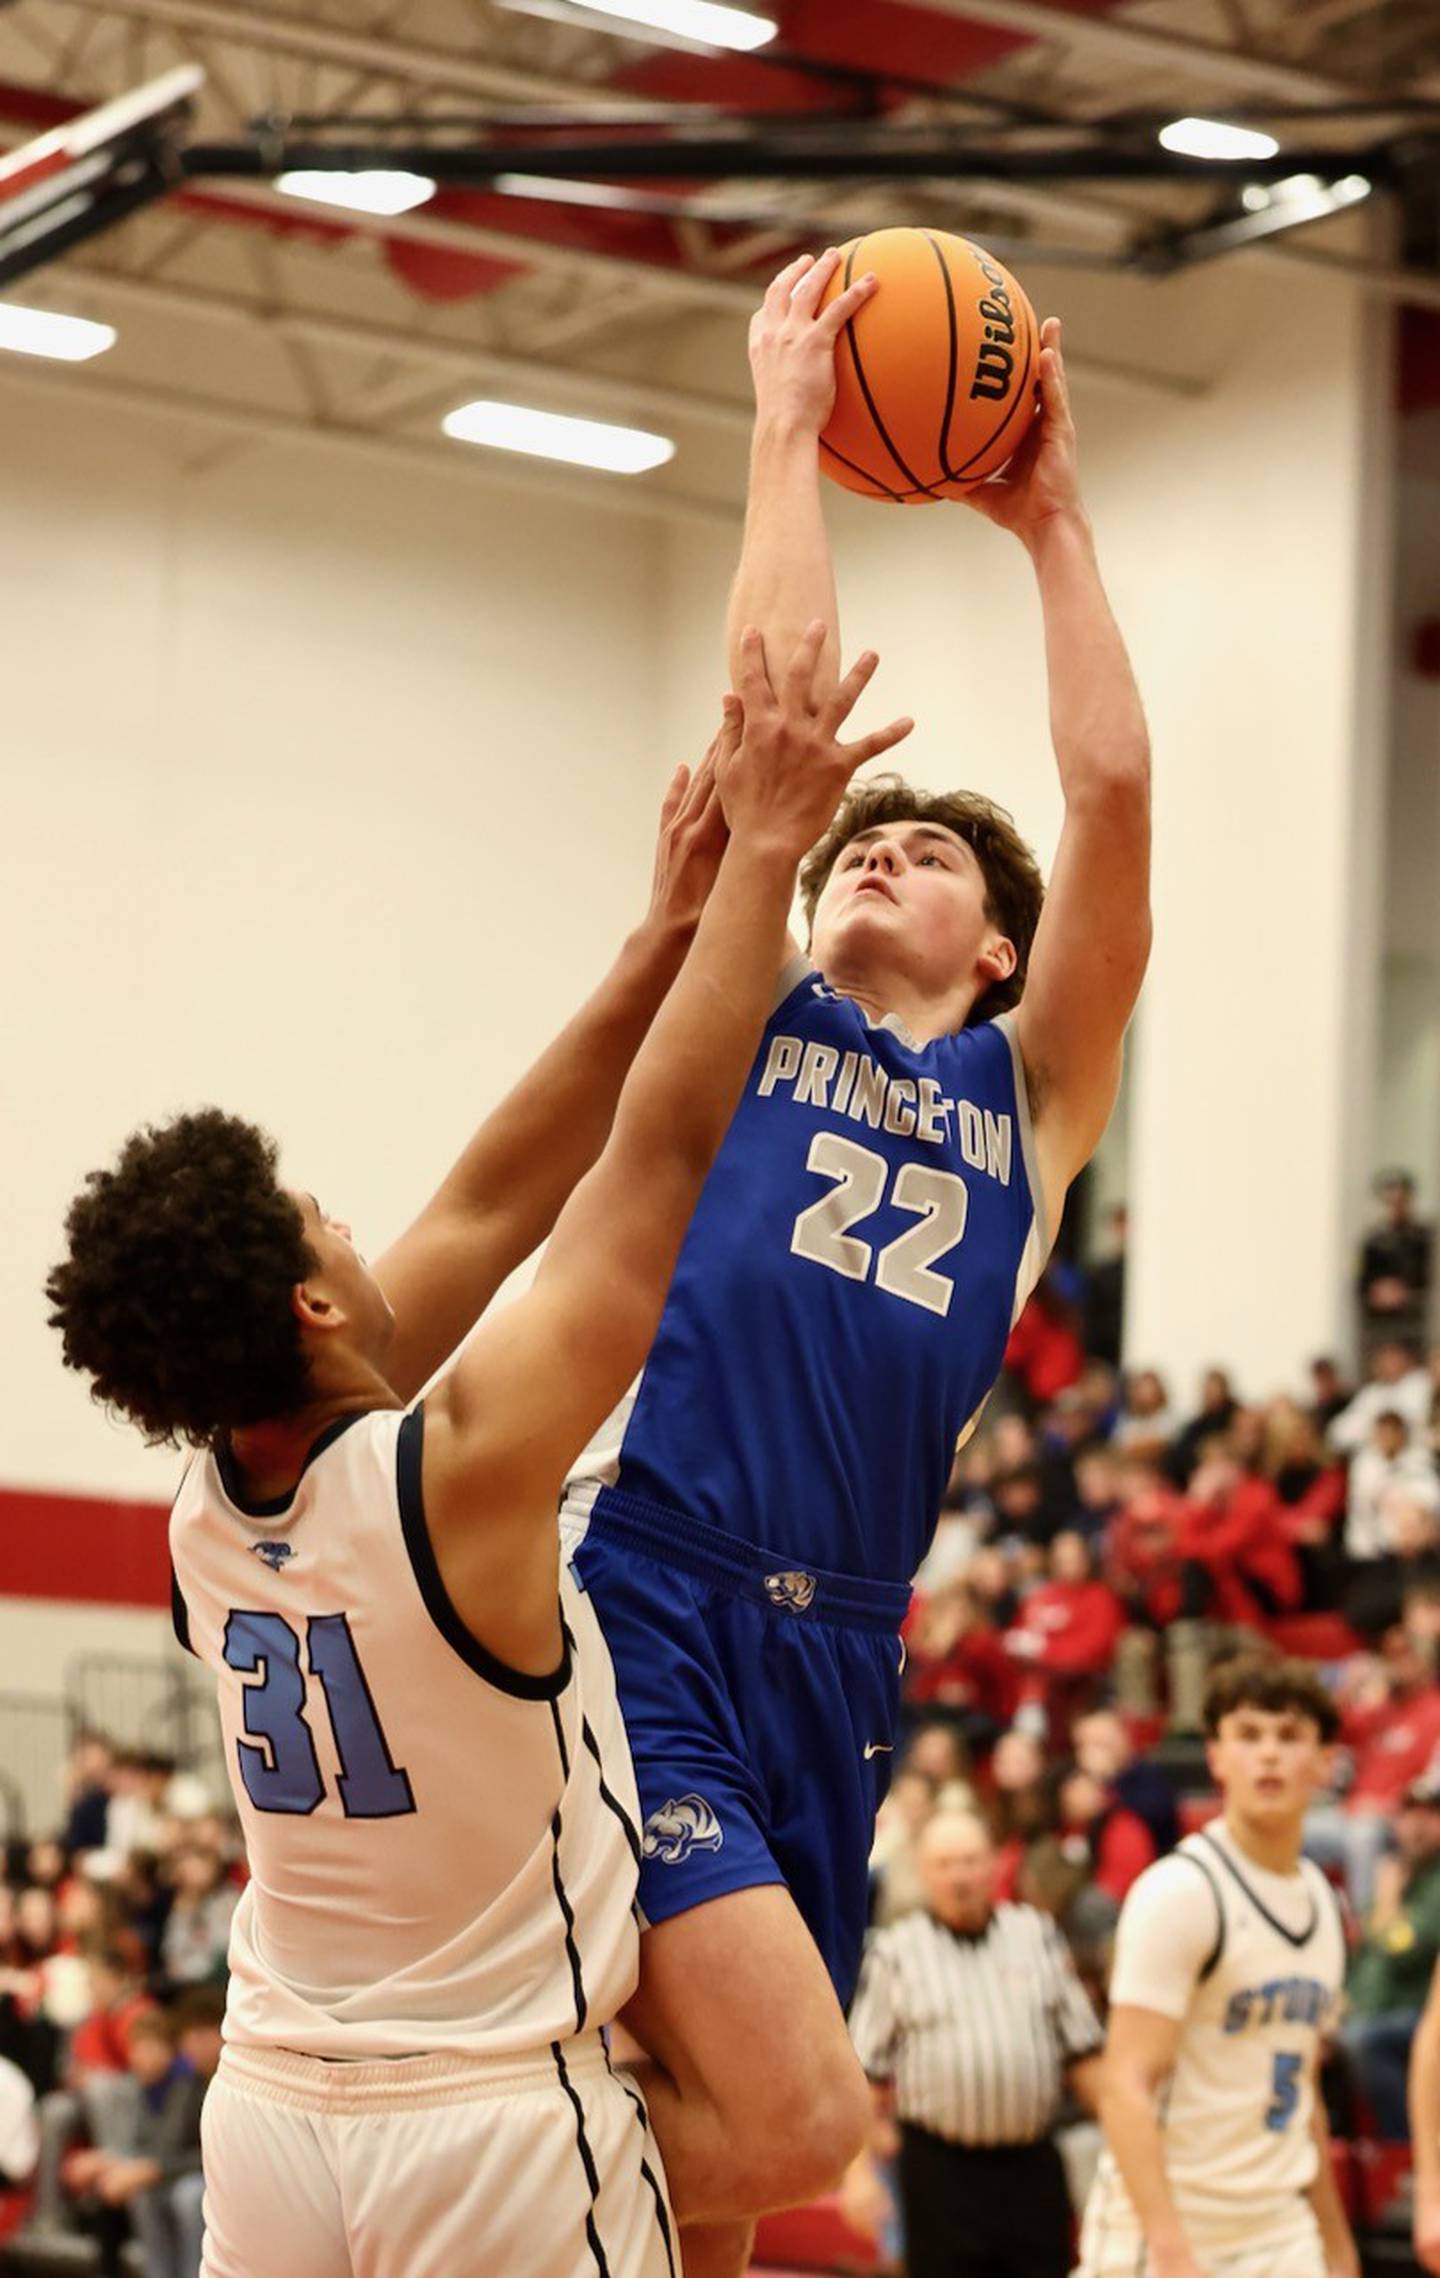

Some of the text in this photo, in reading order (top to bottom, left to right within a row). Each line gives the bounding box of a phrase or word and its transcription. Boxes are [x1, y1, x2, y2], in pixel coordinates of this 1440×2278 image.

[790, 1131, 968, 1317] 22
[222, 1608, 417, 1818] 31
[1265, 2051, 1302, 2131] 5
